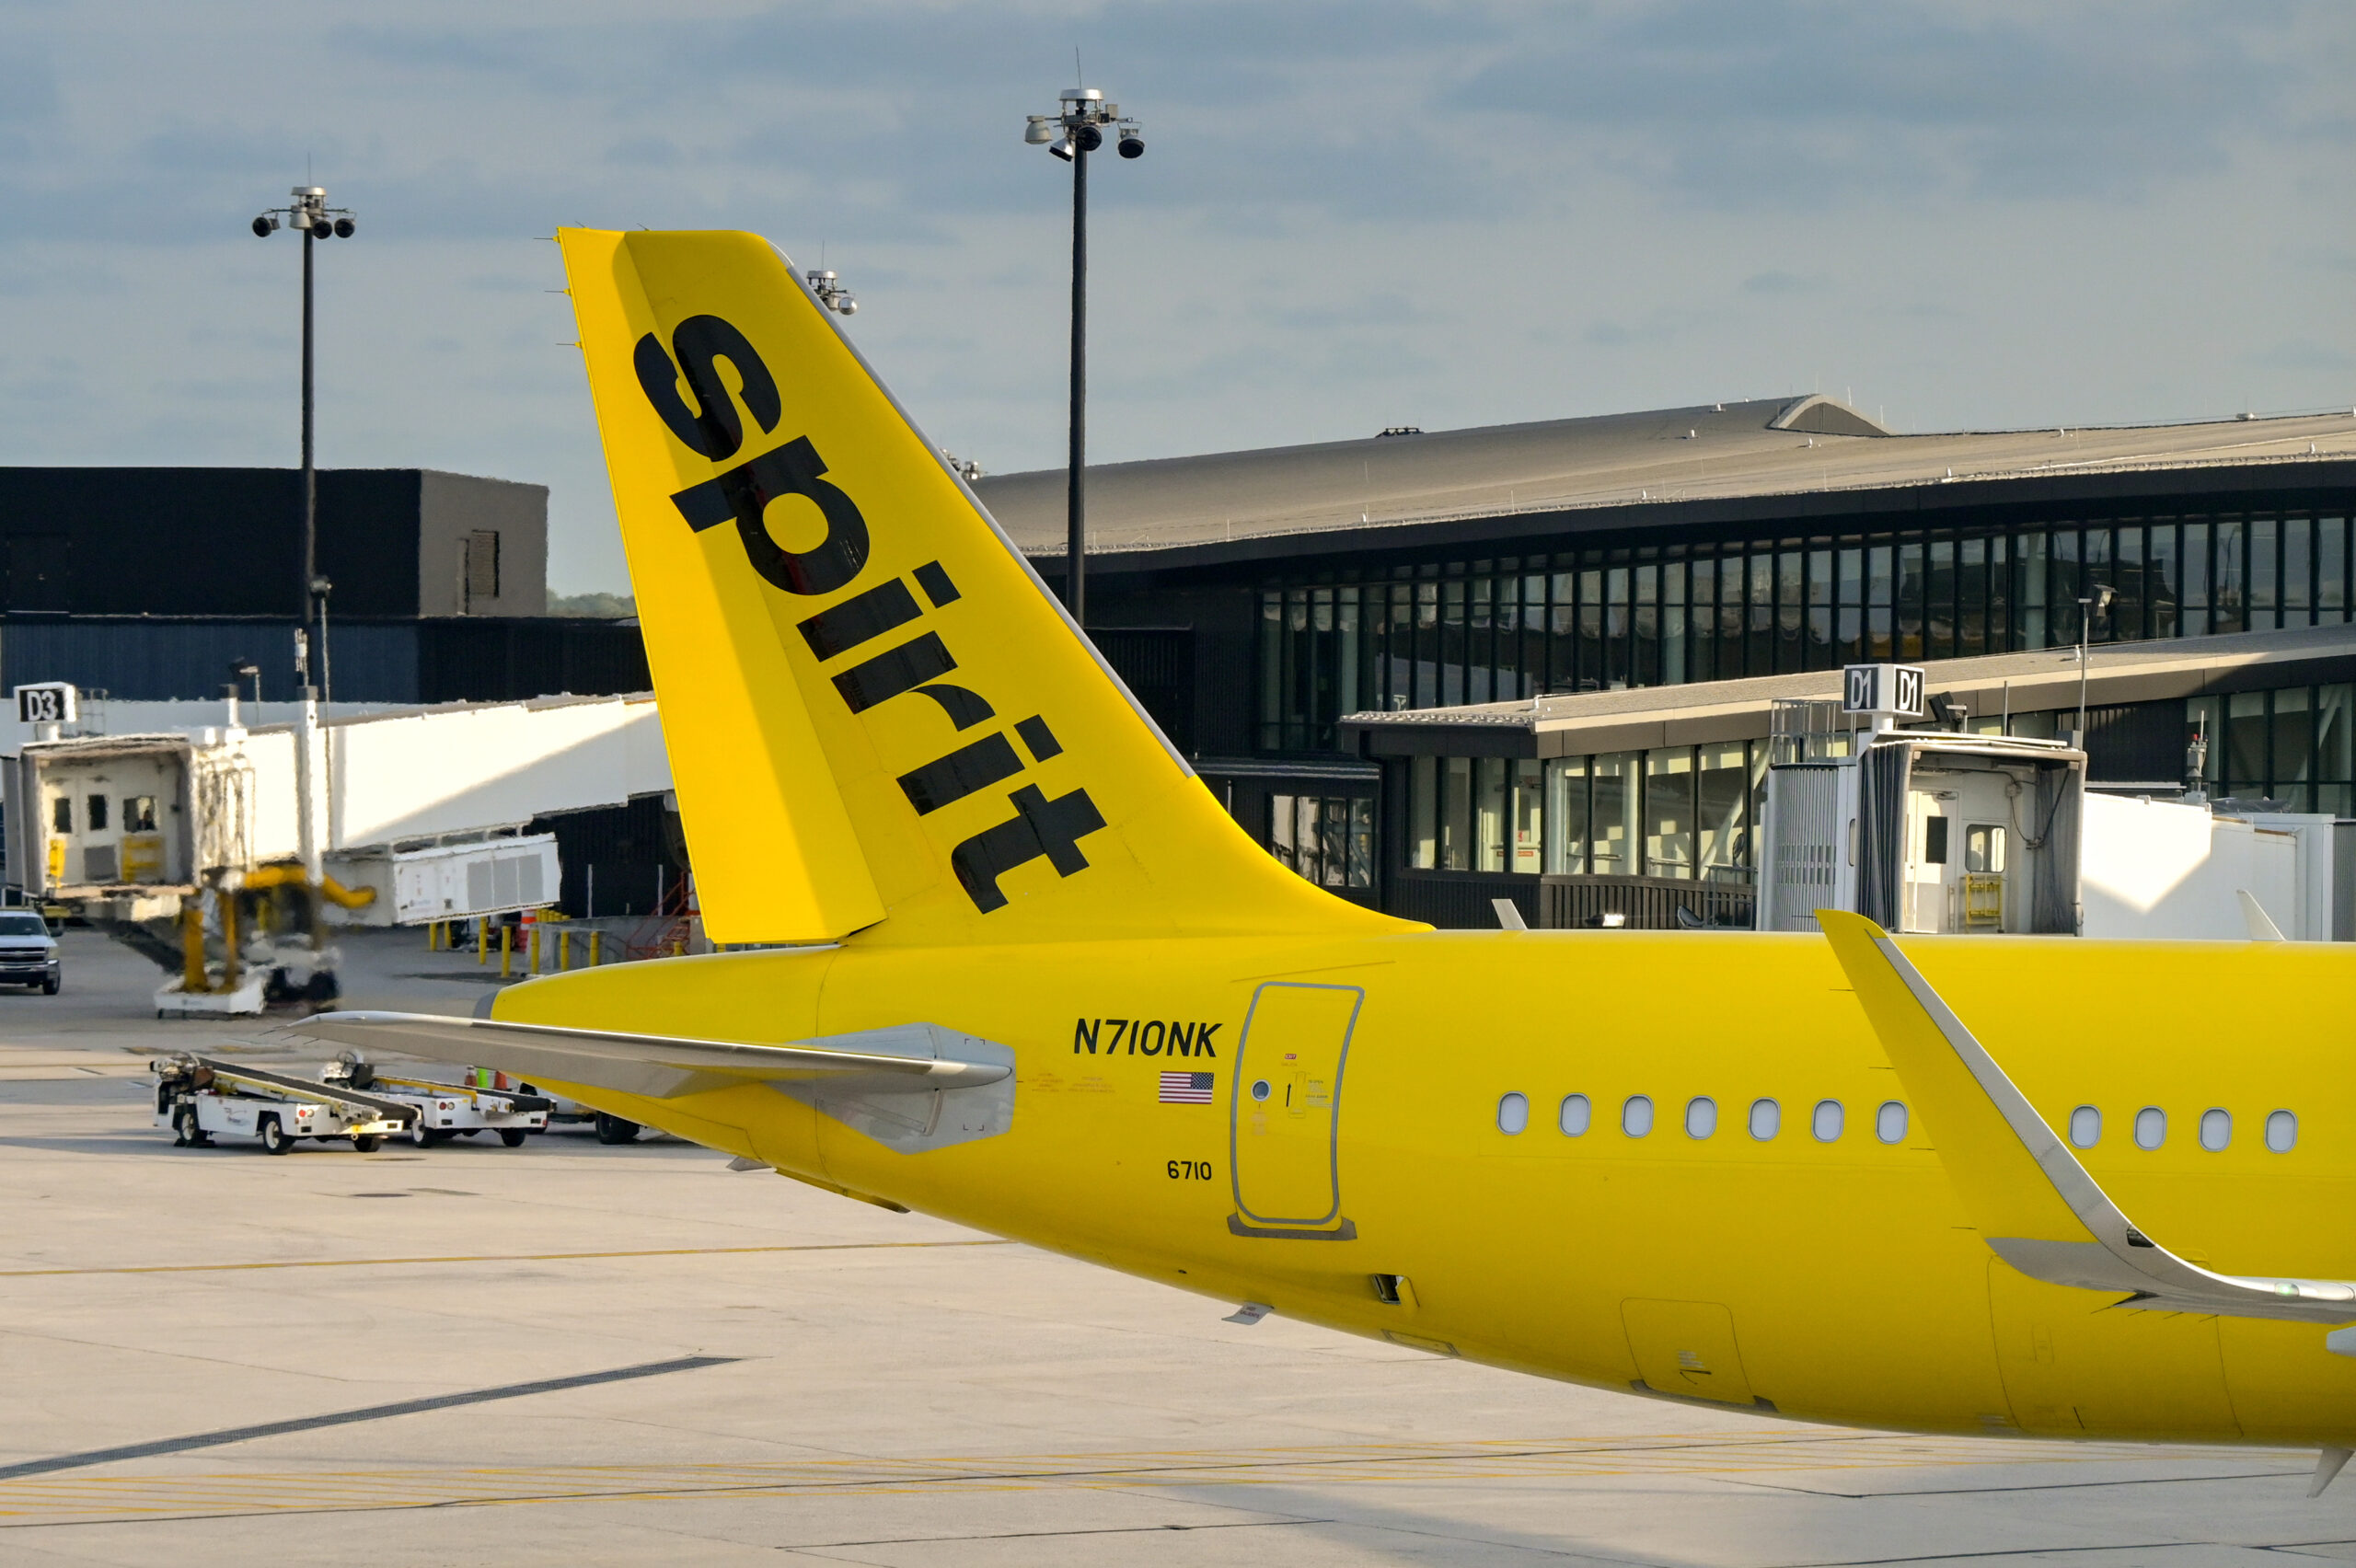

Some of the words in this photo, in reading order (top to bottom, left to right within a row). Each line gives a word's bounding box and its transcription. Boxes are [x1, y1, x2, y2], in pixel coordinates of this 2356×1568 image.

[27, 690, 58, 721] D3
[1851, 669, 1872, 709] D1
[1899, 670, 1918, 712] D1
[1074, 1018, 1223, 1057] N710NK
[1167, 1159, 1212, 1181] 6710
